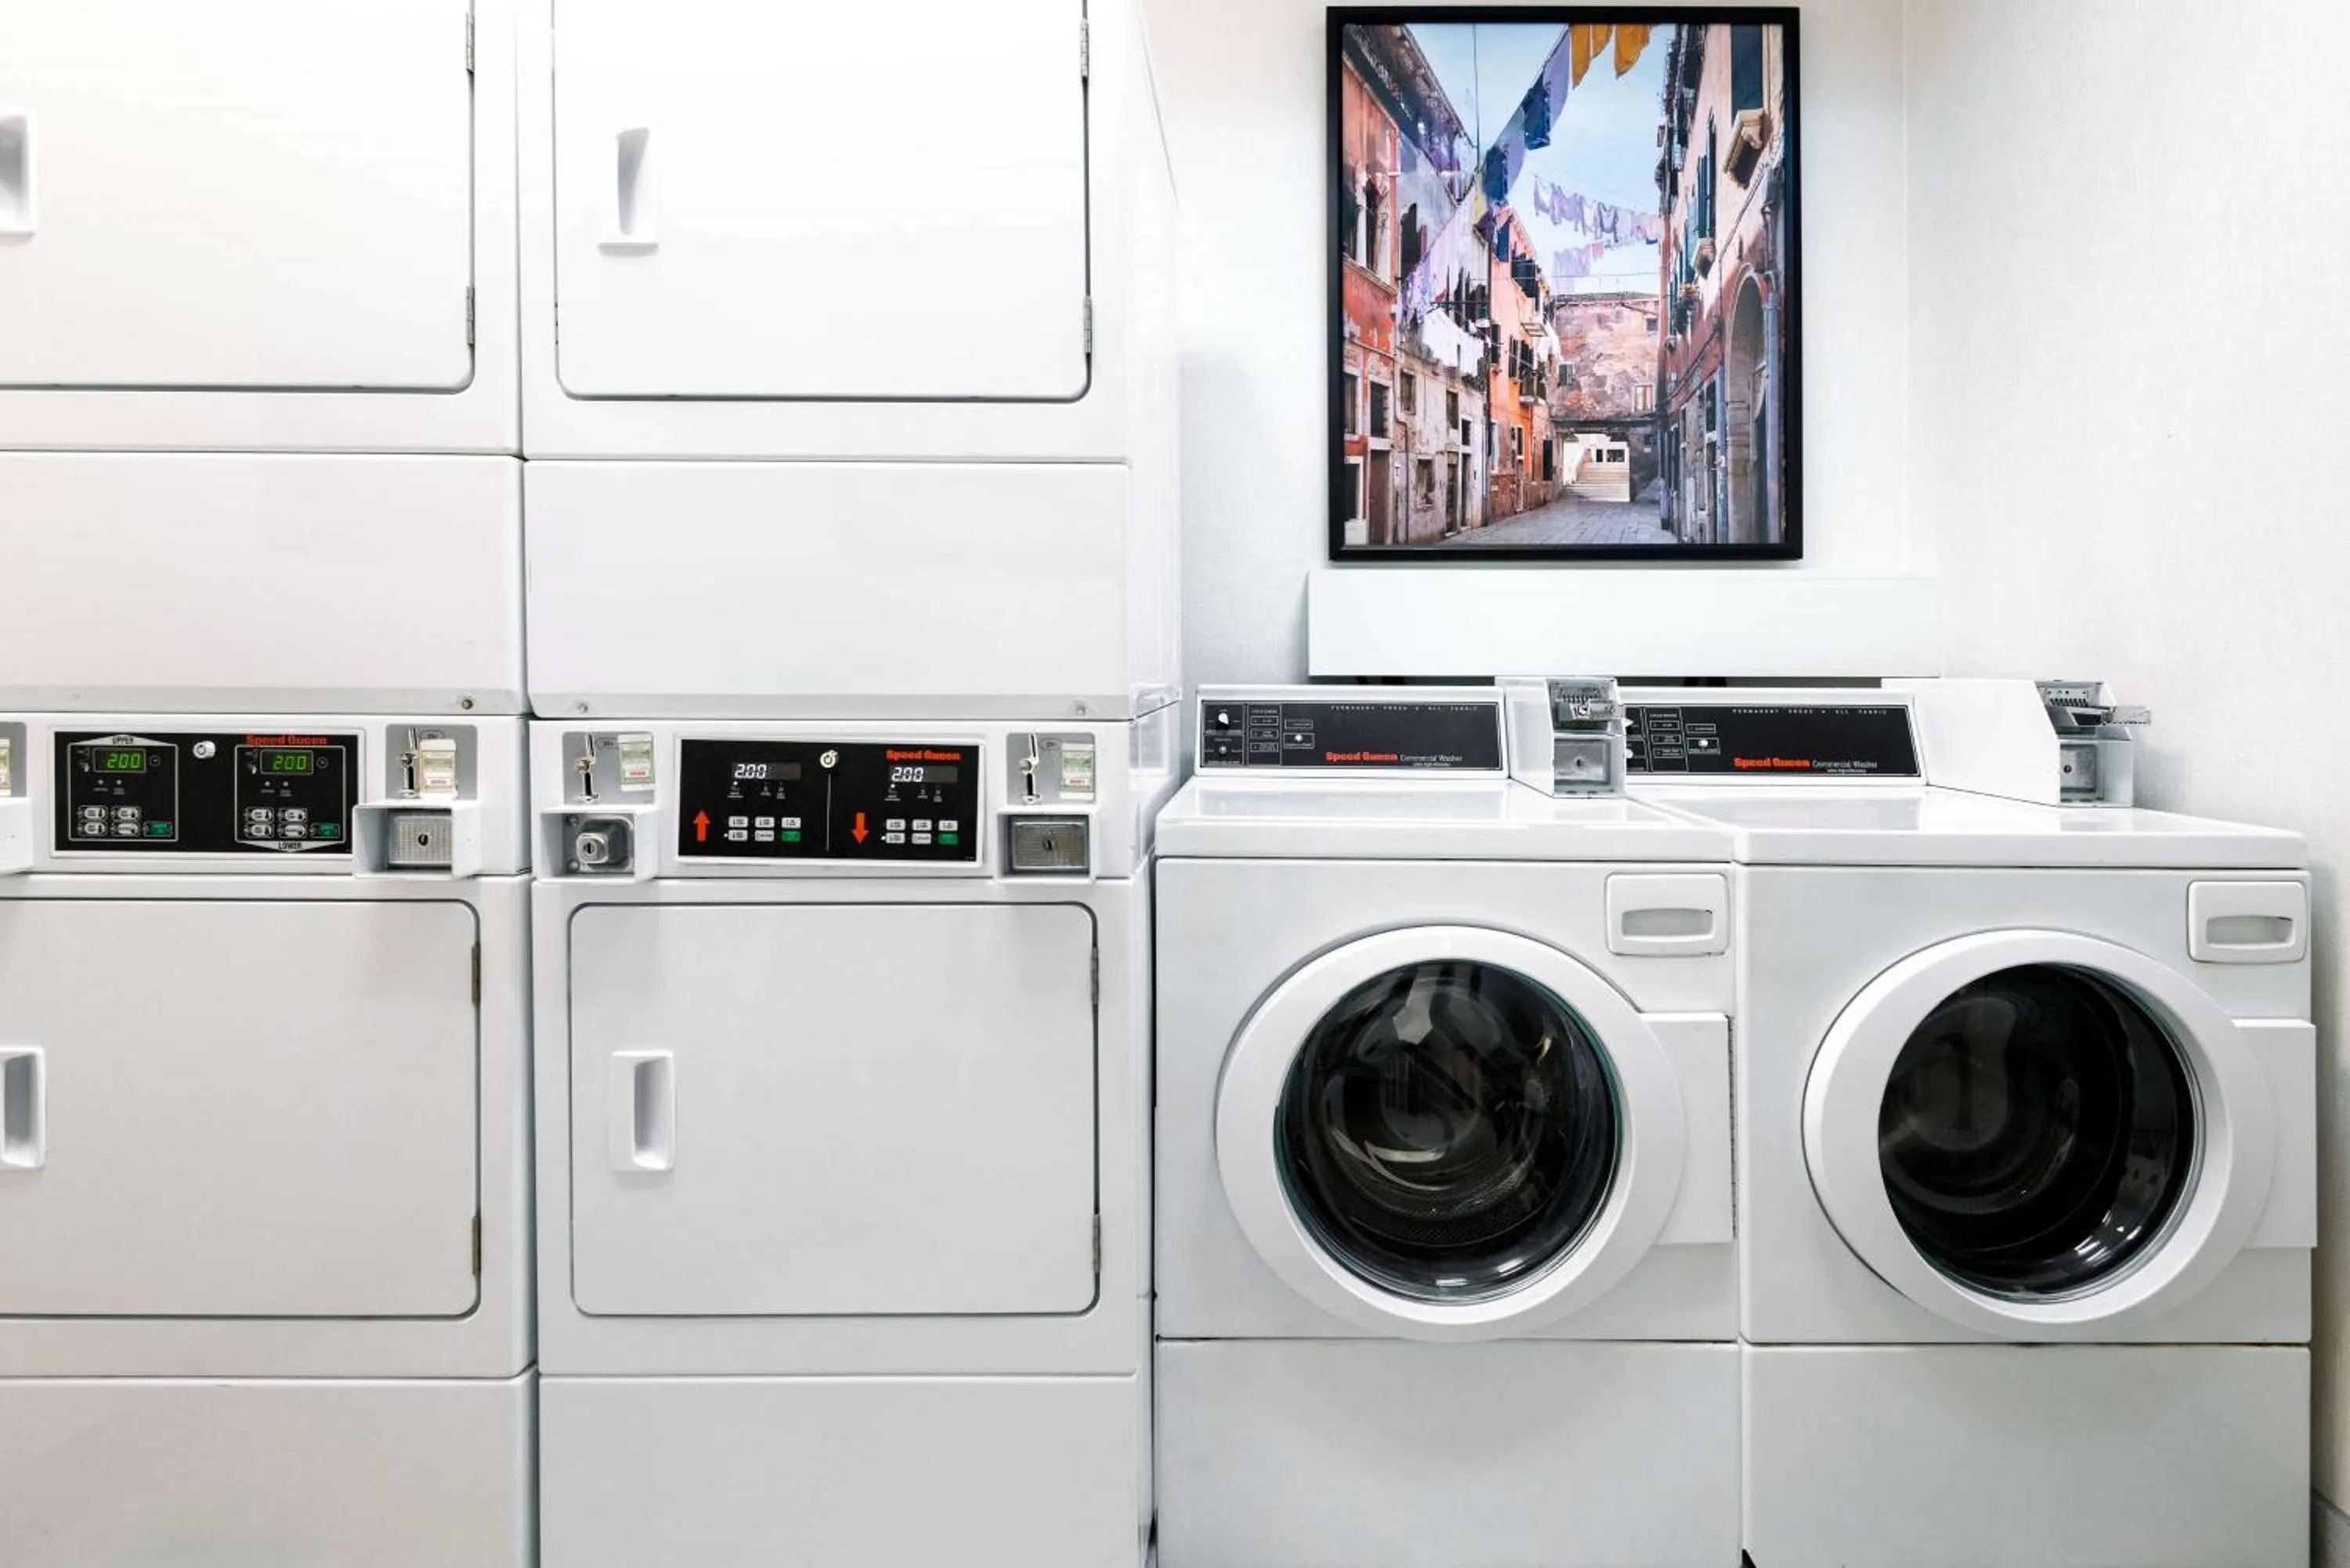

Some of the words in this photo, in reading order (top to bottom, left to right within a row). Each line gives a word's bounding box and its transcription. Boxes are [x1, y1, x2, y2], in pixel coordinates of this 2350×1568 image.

[886, 750, 923, 762] Speed
[1325, 751, 1361, 762] Speed
[1362, 751, 1398, 761] Queen
[1734, 757, 1771, 768] Speed
[1772, 757, 1810, 768] Queen
